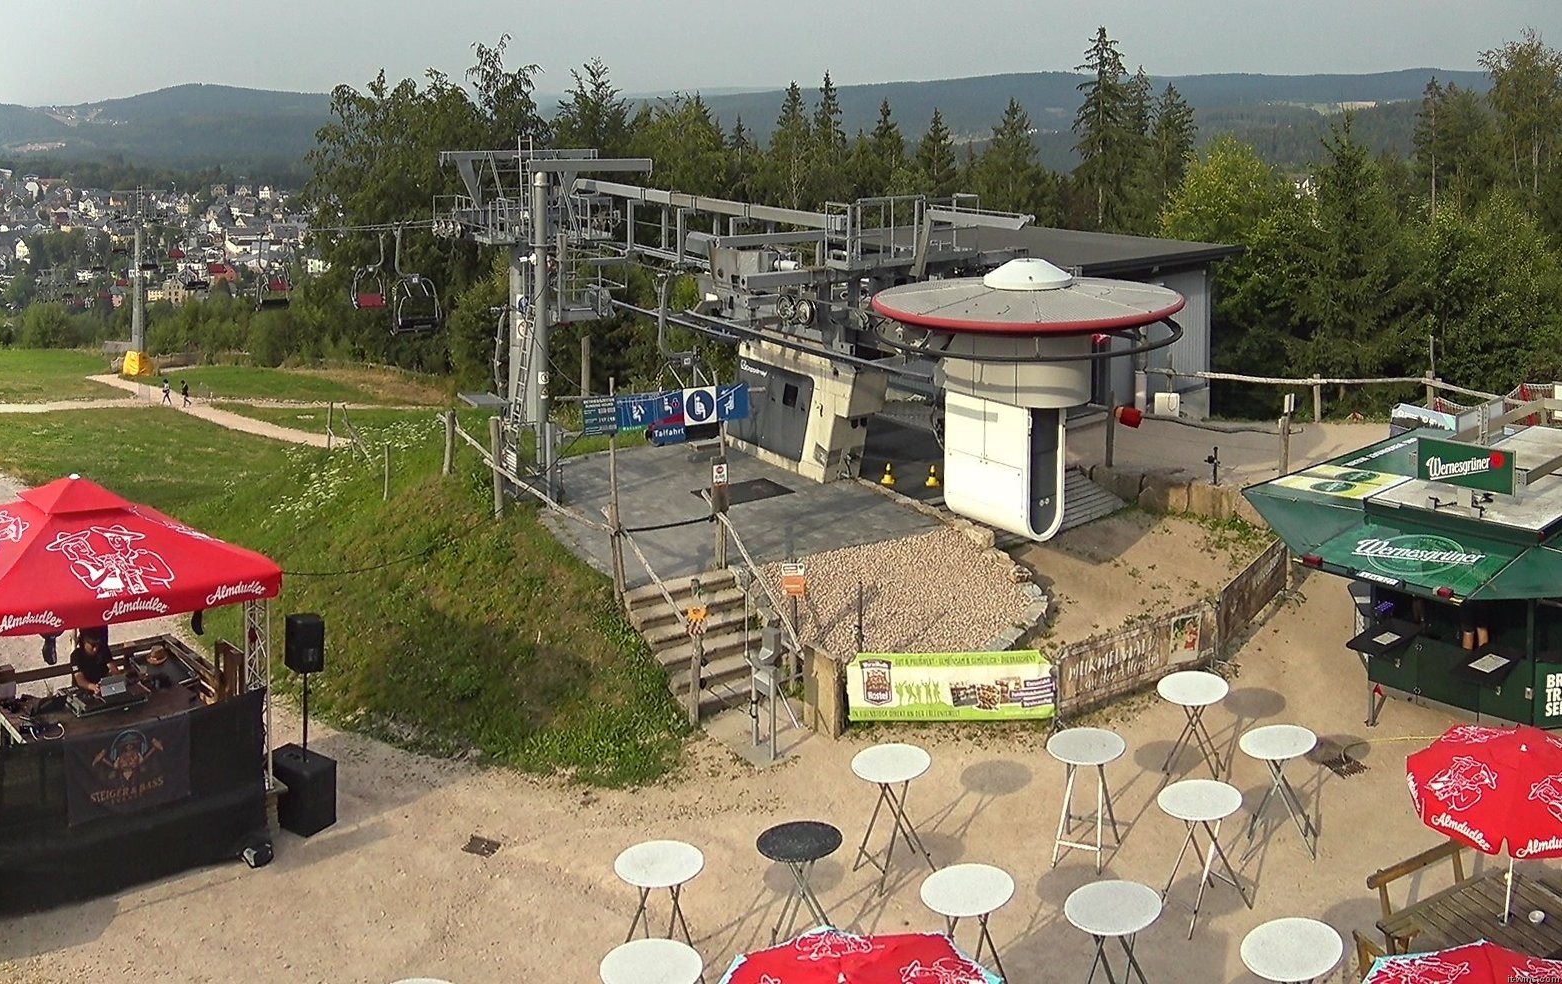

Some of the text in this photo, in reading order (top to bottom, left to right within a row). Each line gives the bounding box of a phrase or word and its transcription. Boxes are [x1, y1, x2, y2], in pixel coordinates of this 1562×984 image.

[653, 427, 685, 437] Talfahrt
[1426, 455, 1491, 478] Wernesgrüner
[1352, 538, 1486, 565] Wernesgrüner
[206, 580, 268, 605] Almdudler
[102, 597, 169, 621] Almdudler
[1545, 688, 1562, 702] TR
[1431, 812, 1492, 851] Almdudler
[1515, 835, 1562, 857] Almdu
